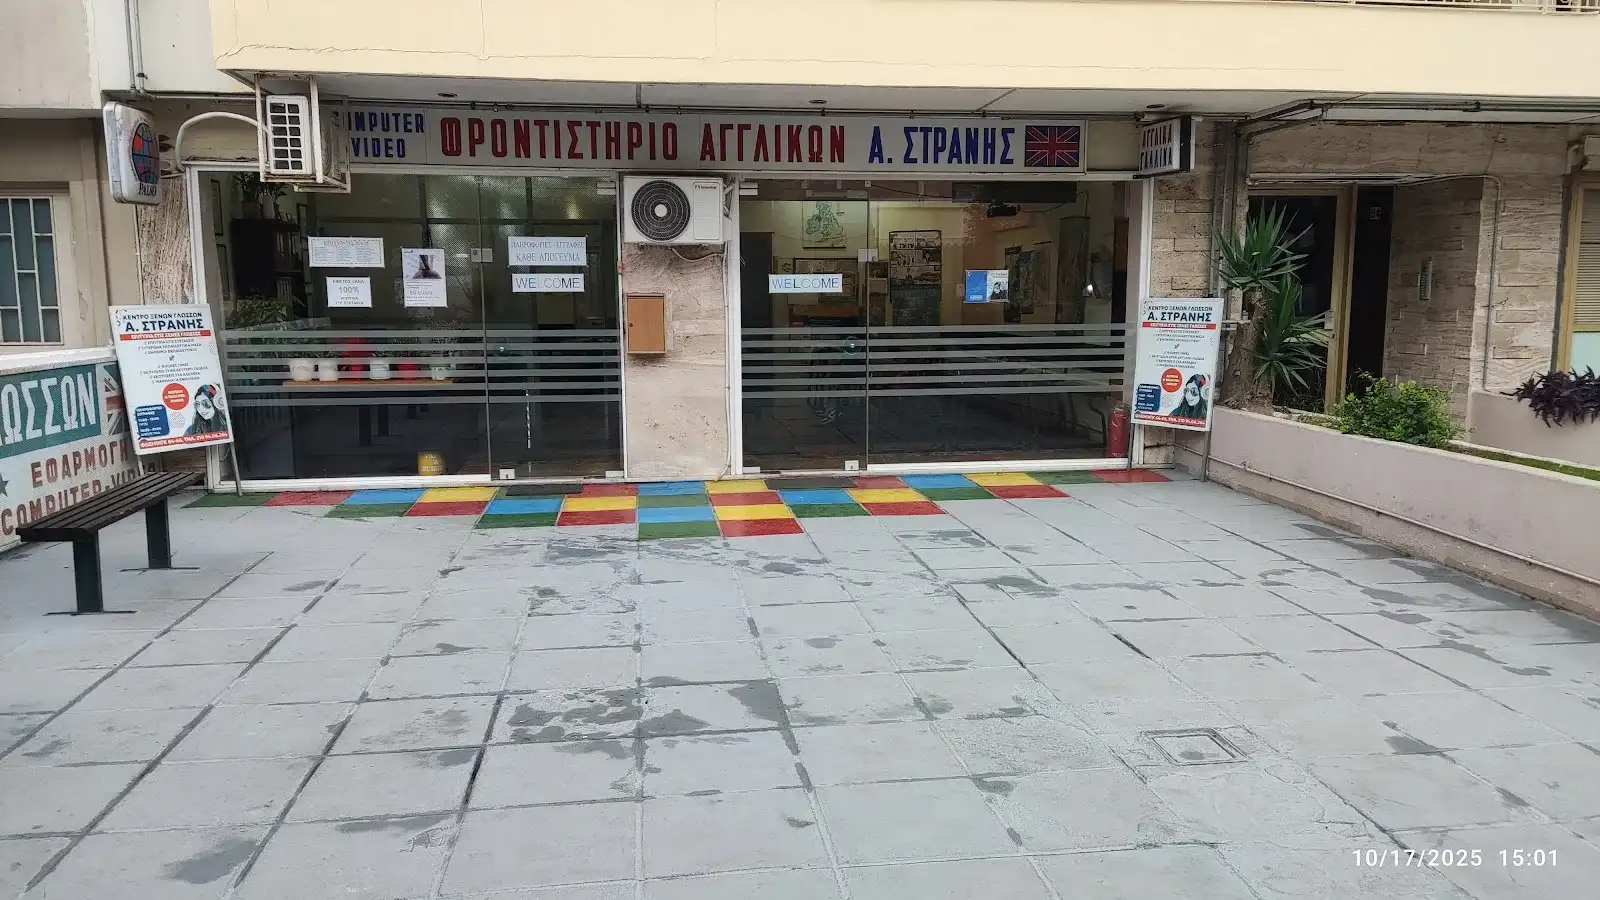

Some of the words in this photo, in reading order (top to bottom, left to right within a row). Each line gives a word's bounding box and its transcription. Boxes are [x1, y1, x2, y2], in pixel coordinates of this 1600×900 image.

[343, 111, 425, 134] MPUTER
[440, 116, 678, 161] ΦΡΟΝΤΙΣΤΗΡΙΟ
[700, 123, 845, 163] ΑΓΓΛΙΚΩΝ
[868, 125, 893, 164] Α.
[903, 126, 1015, 165] ΣΤΡΑΝΗΣ
[350, 137, 406, 159] VIDEO
[511, 241, 552, 249] ΠΛΗΡΟΦΟΡΙΕΣ
[556, 241, 585, 249] ΕΓΓΡΑΦΕΣ
[516, 252, 536, 262] ΚΑΘΕ
[539, 252, 581, 262] ΑΠΟΓΕΥΜΑ
[515, 277, 580, 289] WELCOME
[771, 277, 841, 289] WELCOME
[123, 313, 149, 321] ΚΕΝΤΡΟ
[1147, 311, 1158, 321] Α.
[1161, 312, 1212, 322] ΣΤΡΑΝΗΣ
[125, 321, 139, 332] Α.
[143, 319, 204, 332] ΣΤΡΑΝΗΣ
[0, 372, 96, 446] ΩΣΣΩΝ
